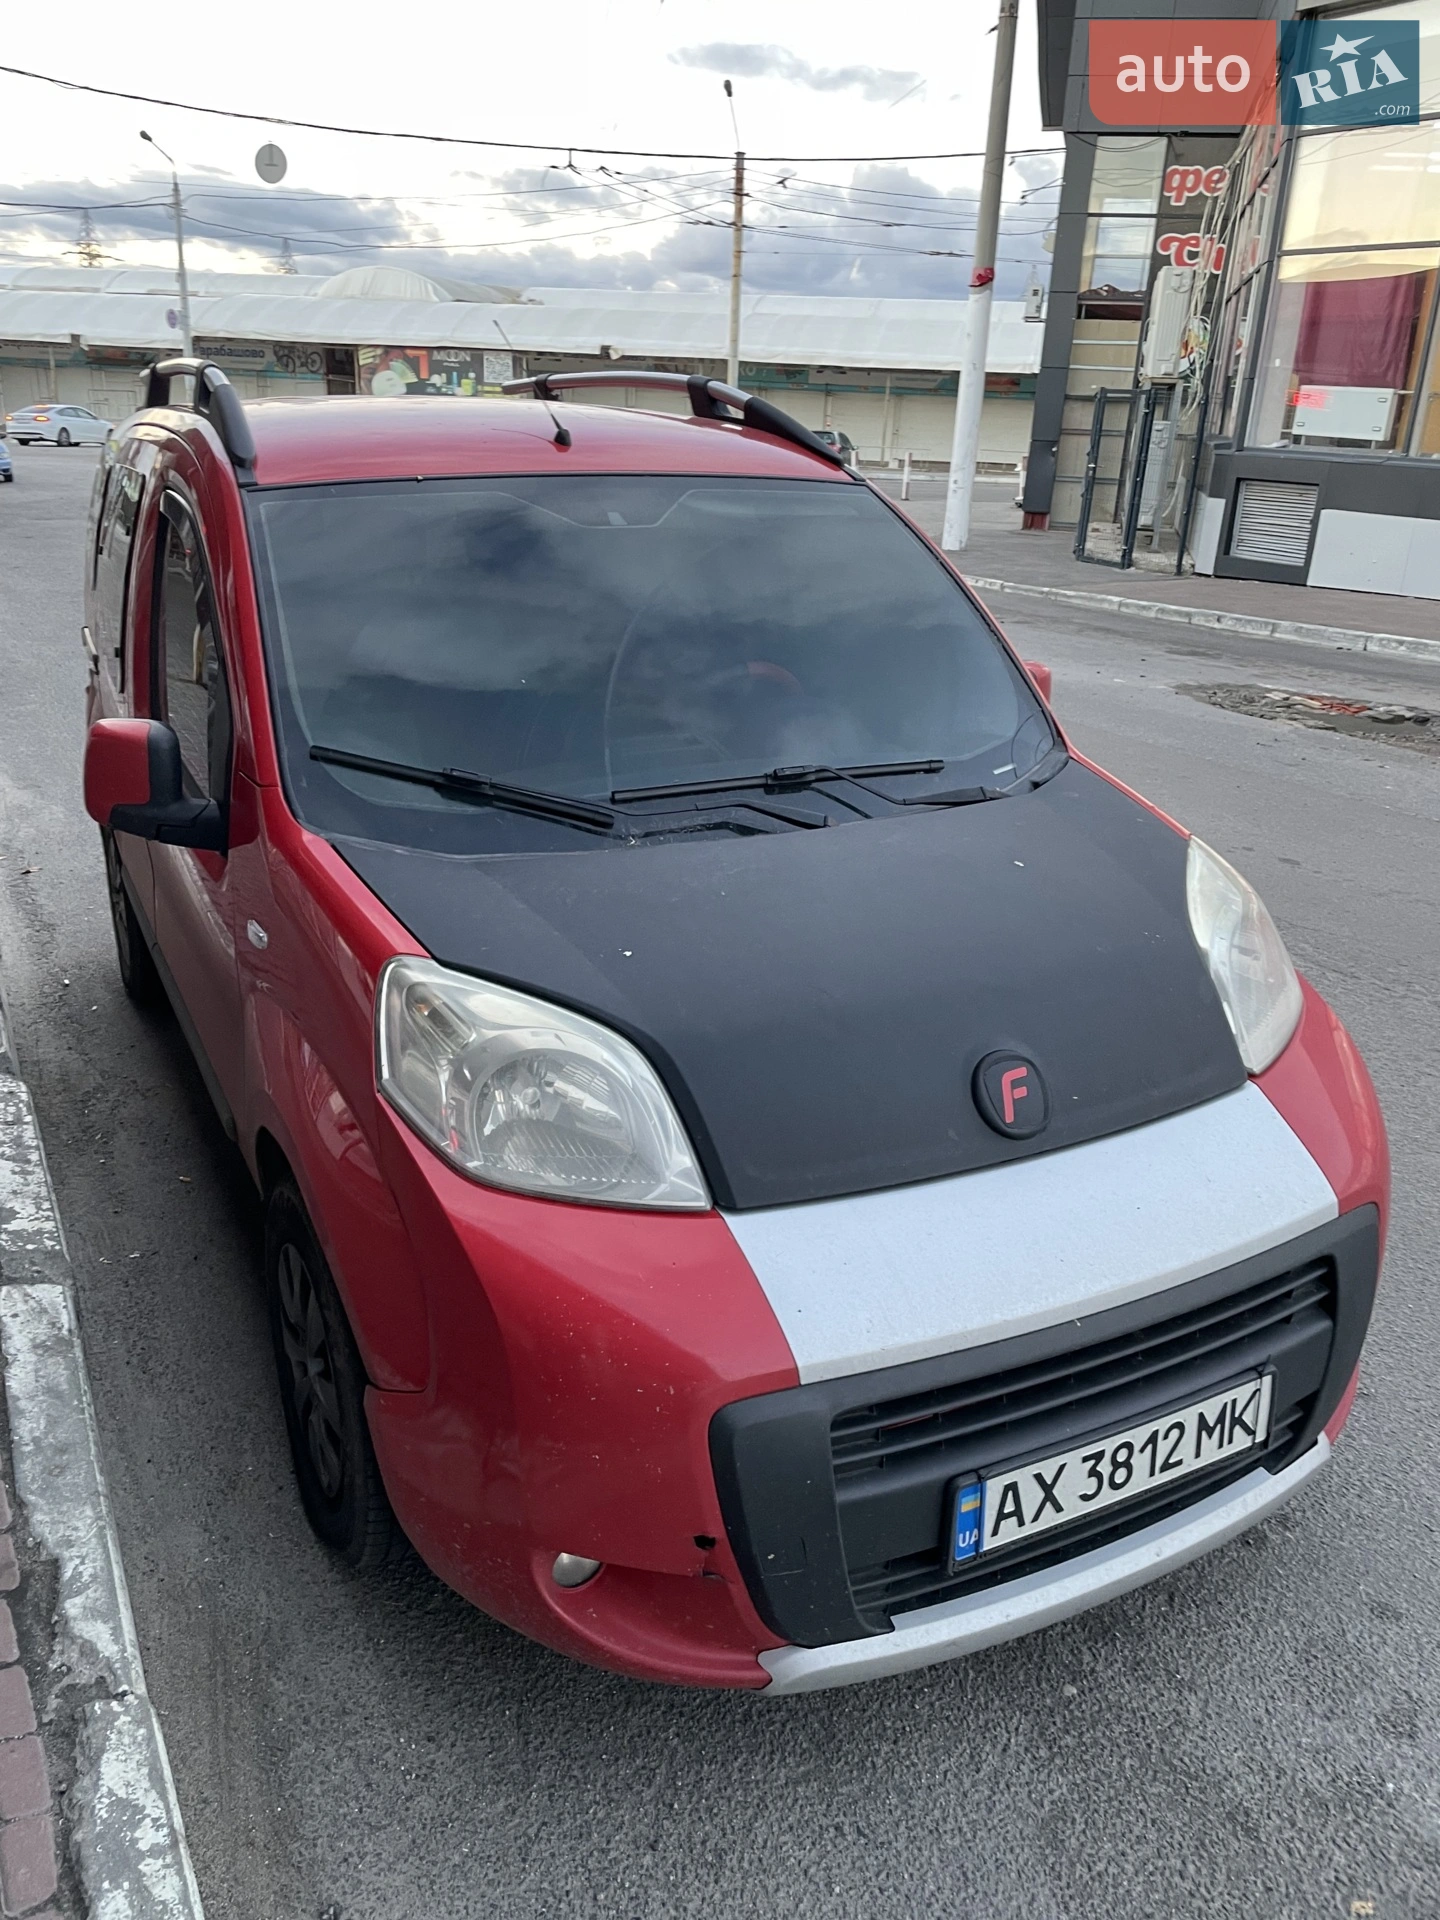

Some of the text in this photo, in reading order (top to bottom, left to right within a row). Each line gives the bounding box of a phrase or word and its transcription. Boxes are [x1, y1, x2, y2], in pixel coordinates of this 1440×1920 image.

[1001, 1066, 1028, 1124] F
[991, 1388, 1261, 1538] AX 3812 MK
[958, 1528, 979, 1548] UA
